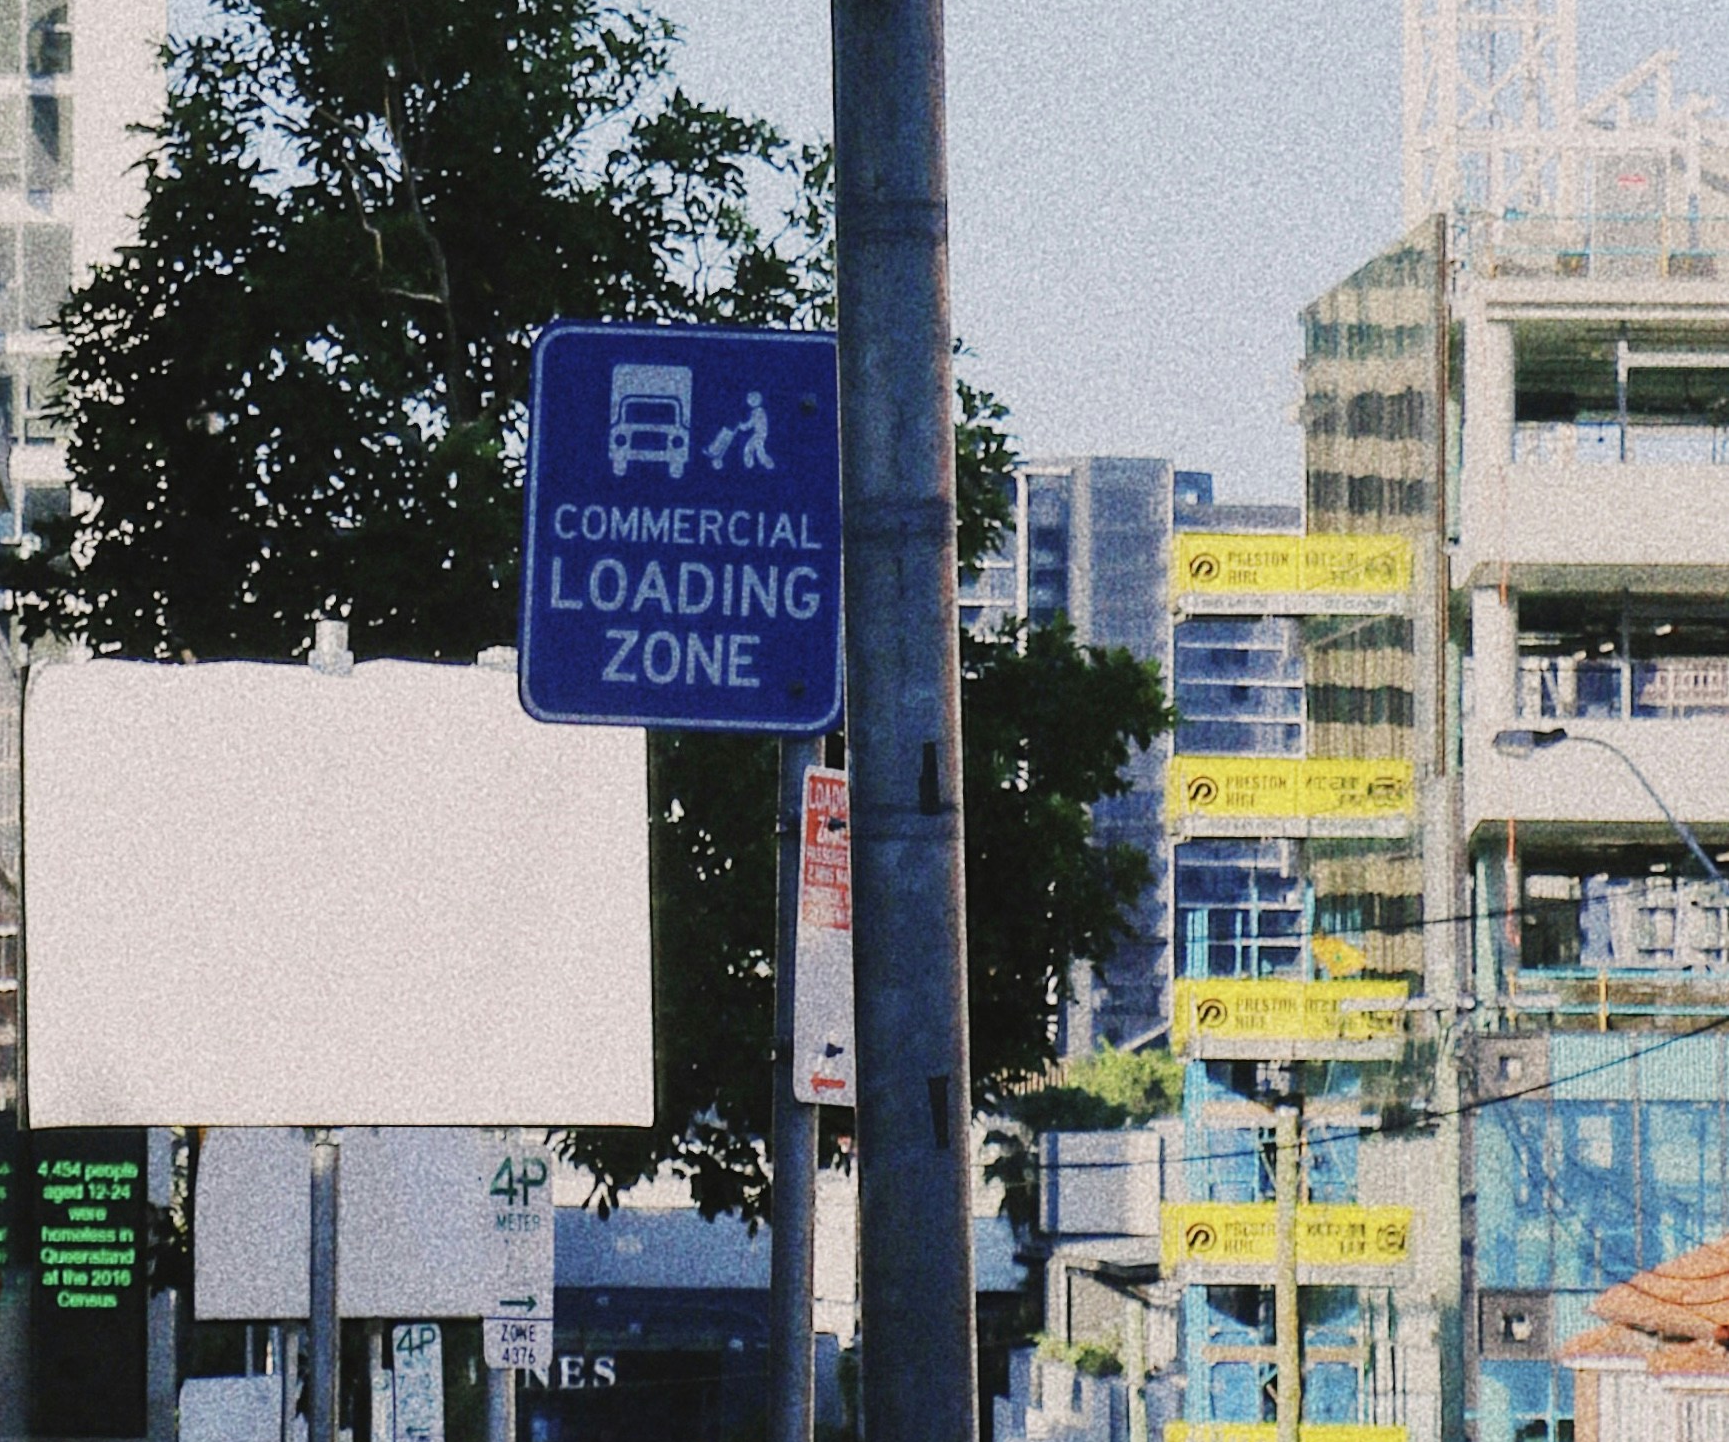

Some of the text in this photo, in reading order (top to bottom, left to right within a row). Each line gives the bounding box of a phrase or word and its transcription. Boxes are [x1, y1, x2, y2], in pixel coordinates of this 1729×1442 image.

[553, 503, 823, 550] COMMERCIAL
[550, 556, 821, 620] LOADING
[601, 628, 761, 688] ZONE
[85, 1161, 139, 1182] people
[489, 1155, 548, 1207] 4P
[43, 1183, 131, 1204] aged 12-24
[41, 1226, 134, 1242] homeless in
[39, 1247, 136, 1265] Queensland
[42, 1269, 132, 1286] at the 2016
[56, 1290, 118, 1308] Census
[396, 1326, 436, 1358] 4P
